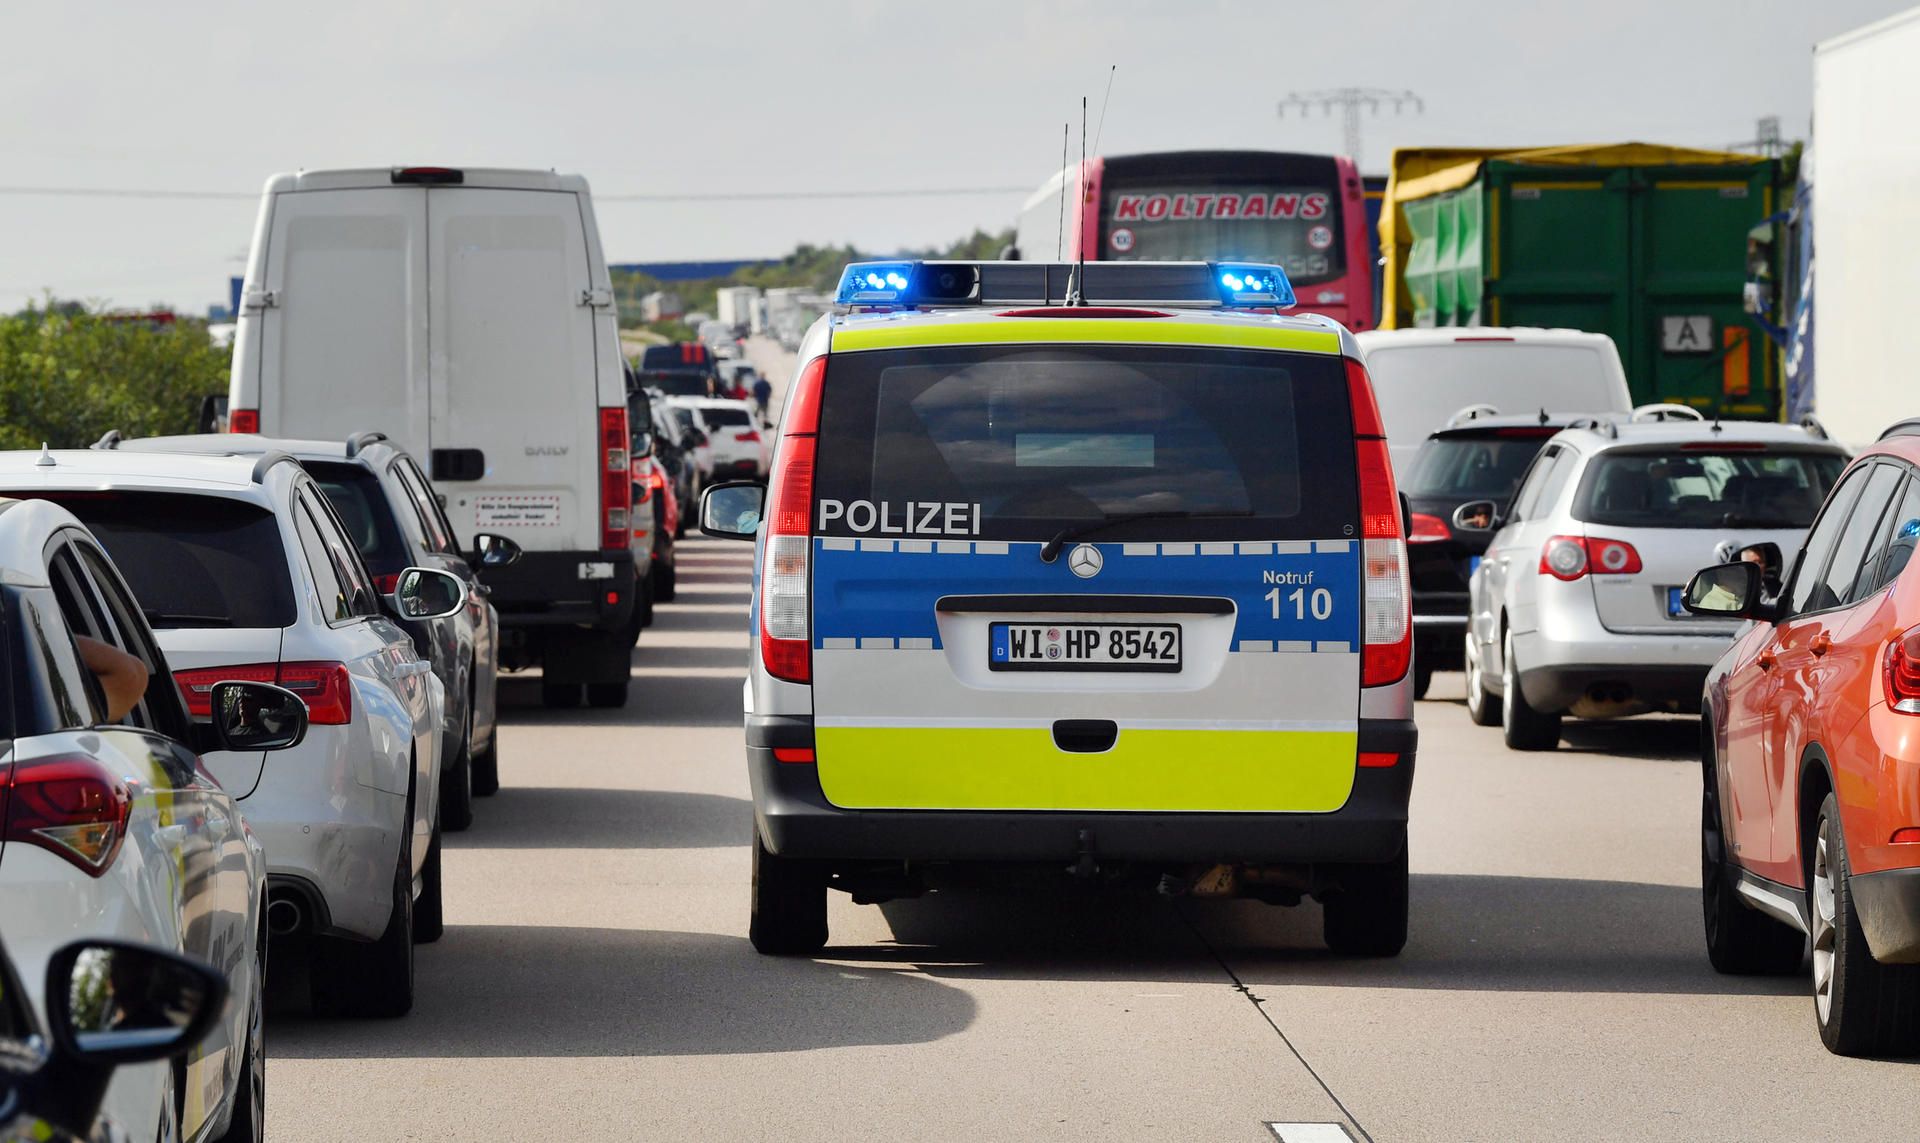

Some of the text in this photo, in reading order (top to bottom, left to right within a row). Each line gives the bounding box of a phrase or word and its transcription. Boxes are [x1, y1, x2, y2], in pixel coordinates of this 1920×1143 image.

[1114, 194, 1329, 221] KOLTRANS
[1678, 317, 1699, 345] A
[525, 446, 568, 456] DAILY
[818, 499, 981, 535] POLIZEI
[1263, 570, 1314, 584] Notruf
[1264, 587, 1332, 620] 110
[997, 629, 1176, 660] D WI HP 8542
